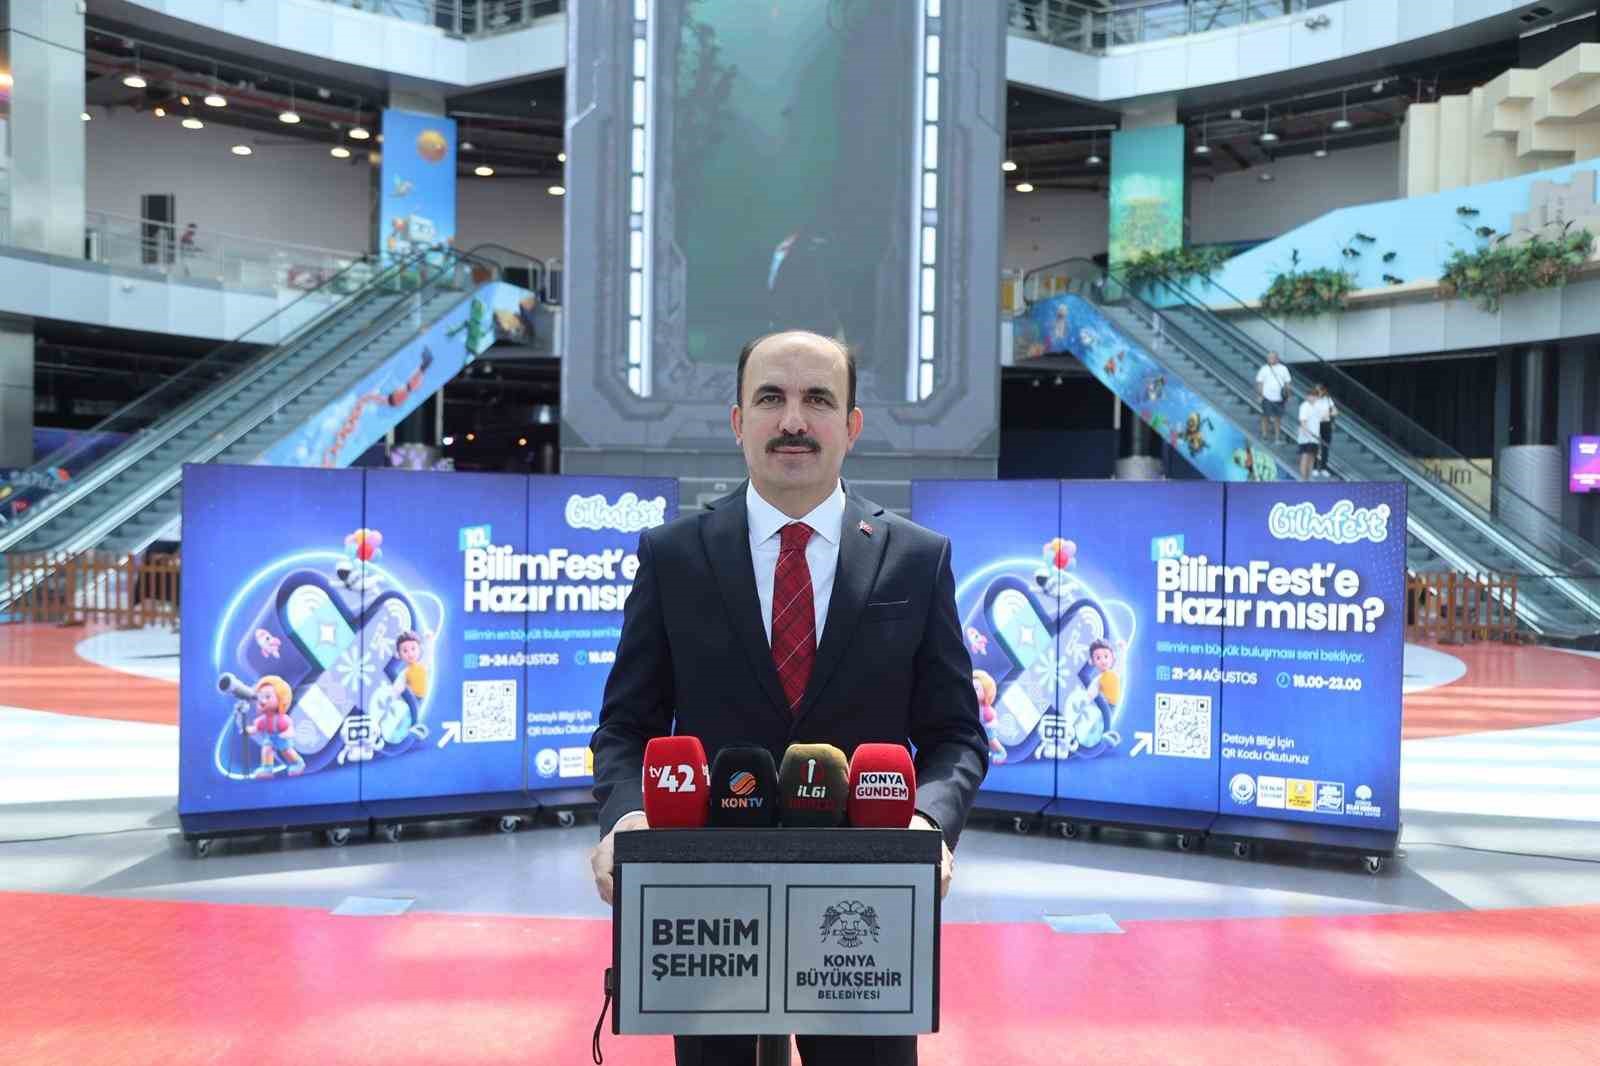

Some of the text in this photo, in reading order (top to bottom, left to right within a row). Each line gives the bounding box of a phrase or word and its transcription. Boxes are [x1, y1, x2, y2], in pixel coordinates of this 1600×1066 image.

[1157, 555, 1360, 597] BilimFest'e
[464, 581, 553, 612] Hazır
[1156, 591, 1385, 633] Hazır mısın?
[1203, 667, 1258, 685] AĞUSTOS
[1222, 747, 1236, 758] QR
[1237, 748, 1262, 760] Kodu
[861, 774, 903, 785] KONYA
[857, 786, 907, 798] GÜNDEM
[721, 797, 763, 808] KONTV
[652, 918, 759, 946] BENİM
[651, 953, 759, 981] ŞEHRİM
[823, 954, 876, 968] KONYA
[795, 967, 903, 989] BÜYÜKŞEHİR
[817, 988, 881, 1000] BELEDİYESİ
